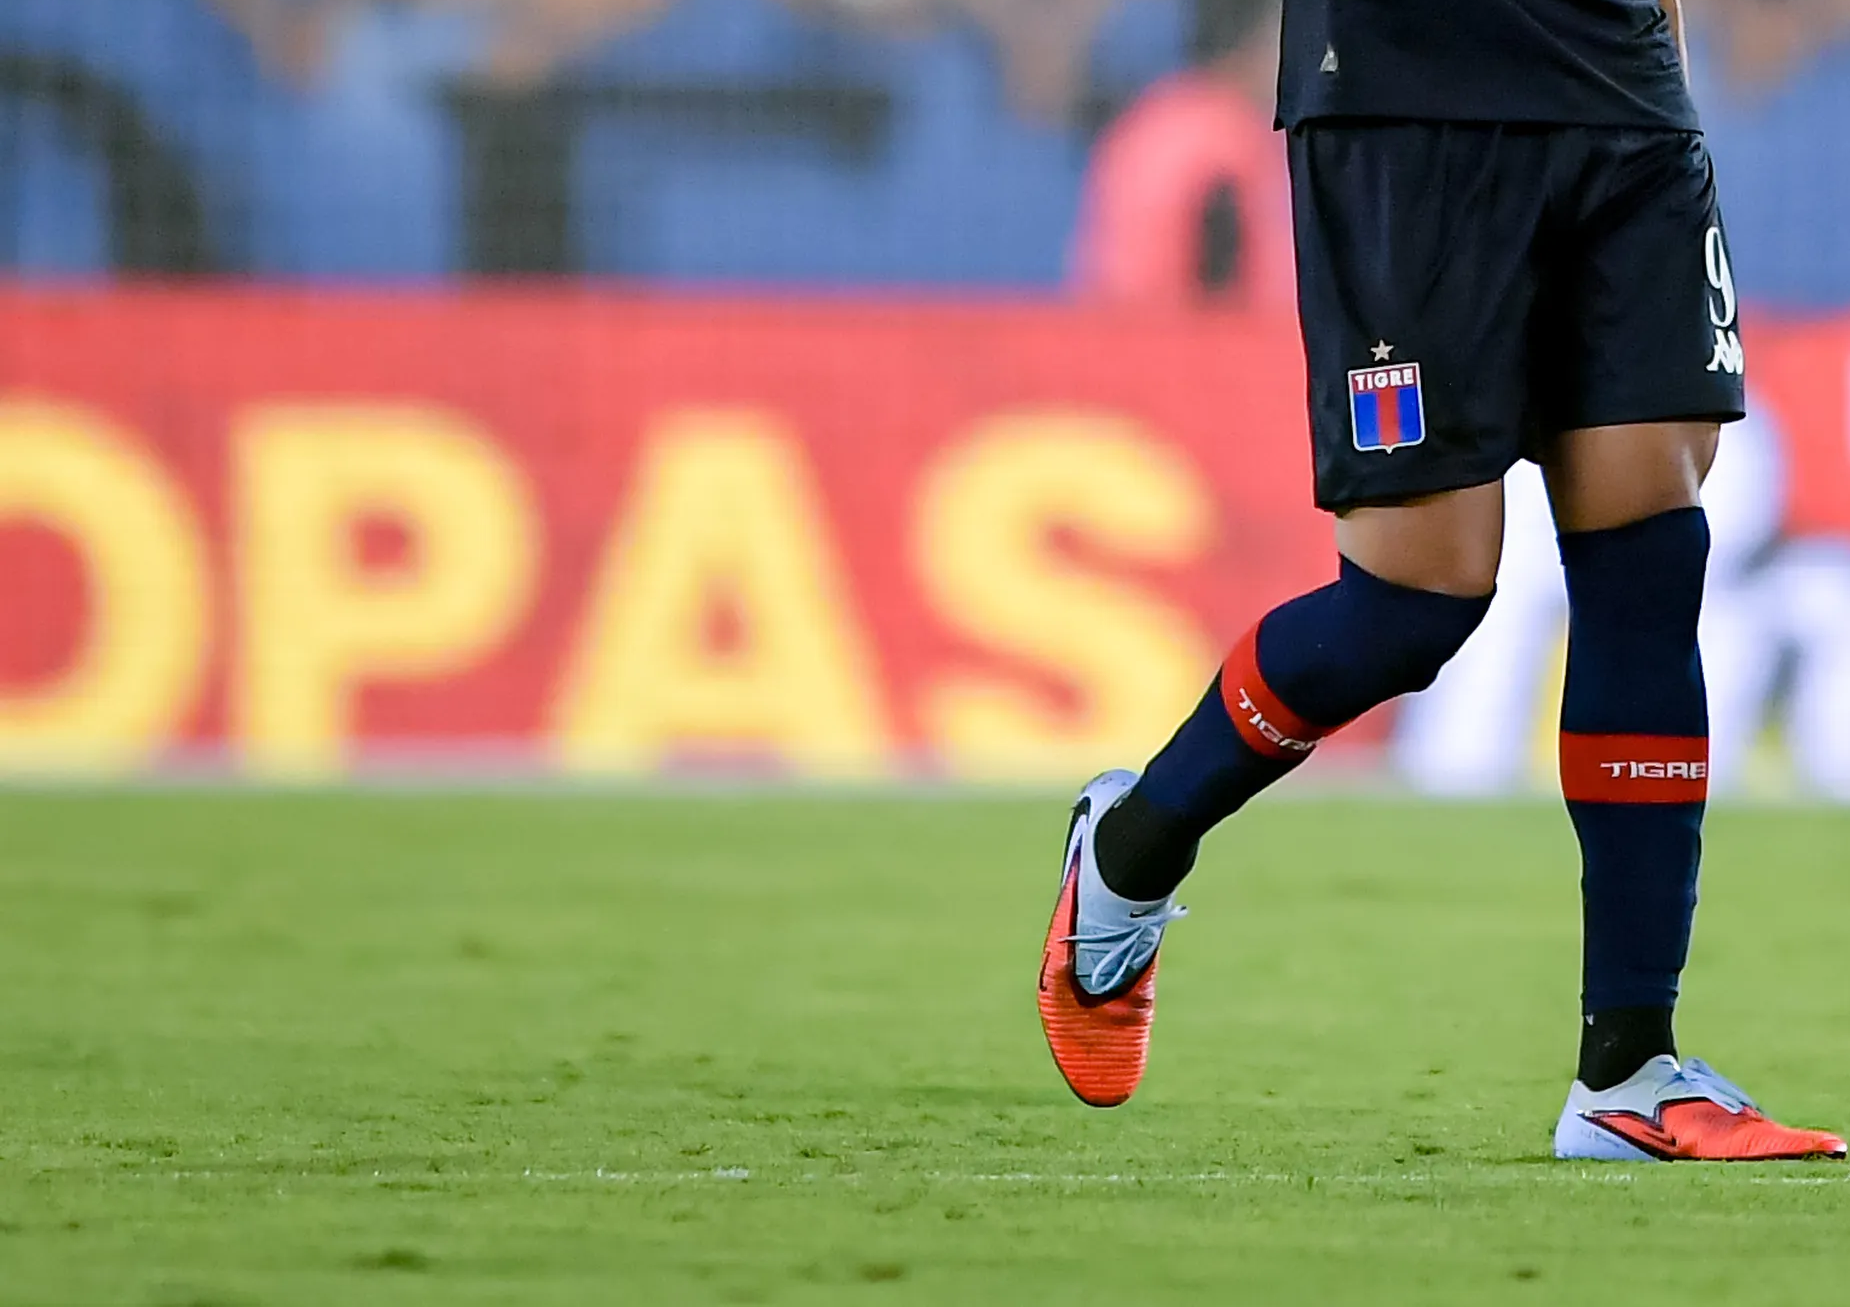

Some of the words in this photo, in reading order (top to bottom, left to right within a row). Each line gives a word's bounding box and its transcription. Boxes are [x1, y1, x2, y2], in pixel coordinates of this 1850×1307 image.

[1704, 226, 1736, 328] 9
[1354, 368, 1414, 391] TIGRE
[1238, 687, 1317, 751] TIGR
[1600, 761, 1707, 780] TIGRE
